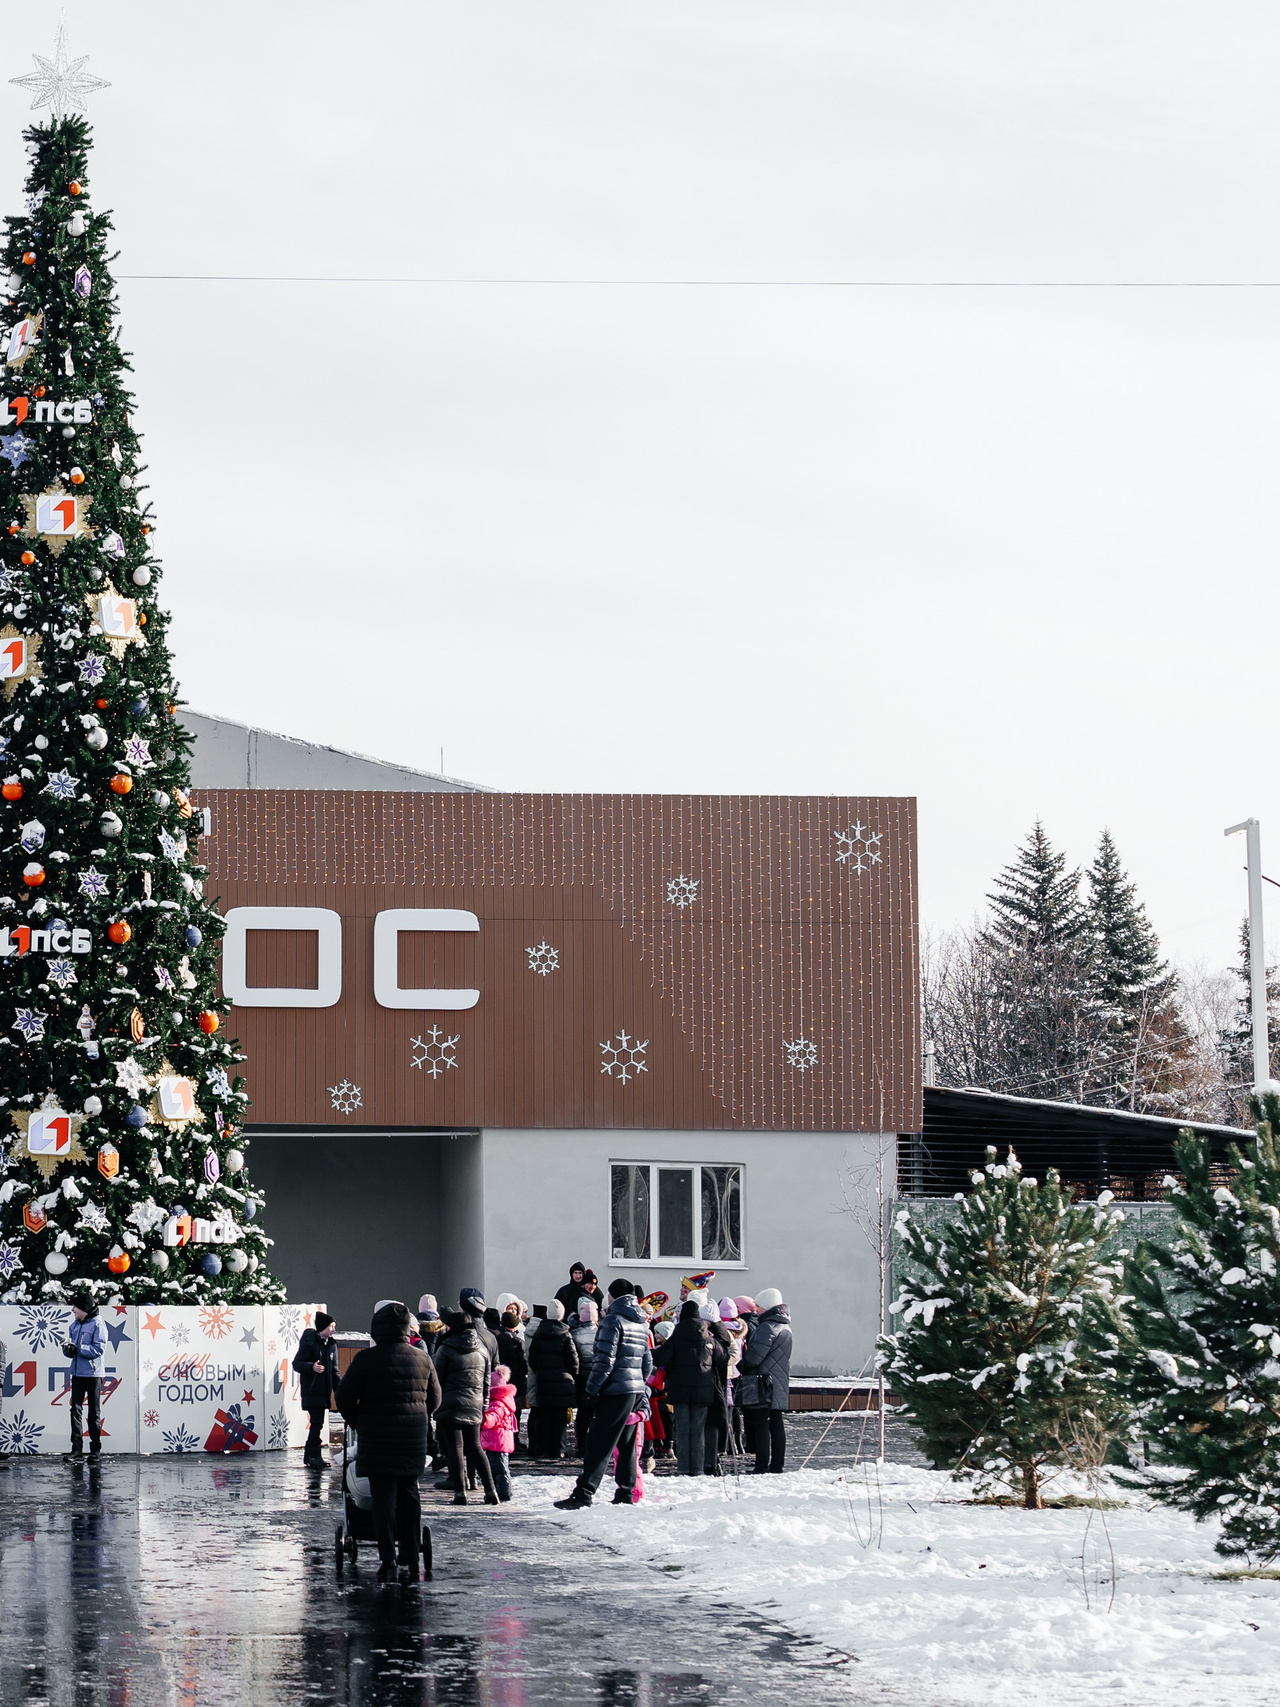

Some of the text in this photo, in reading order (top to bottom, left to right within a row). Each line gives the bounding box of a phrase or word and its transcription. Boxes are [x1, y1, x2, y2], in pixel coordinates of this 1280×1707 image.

[35, 400, 93, 423] ПСБ
[31, 928, 92, 953] ПСБ
[158, 1364, 246, 1382] С НОВЫМ
[158, 1384, 224, 1404] ГОДОМ
